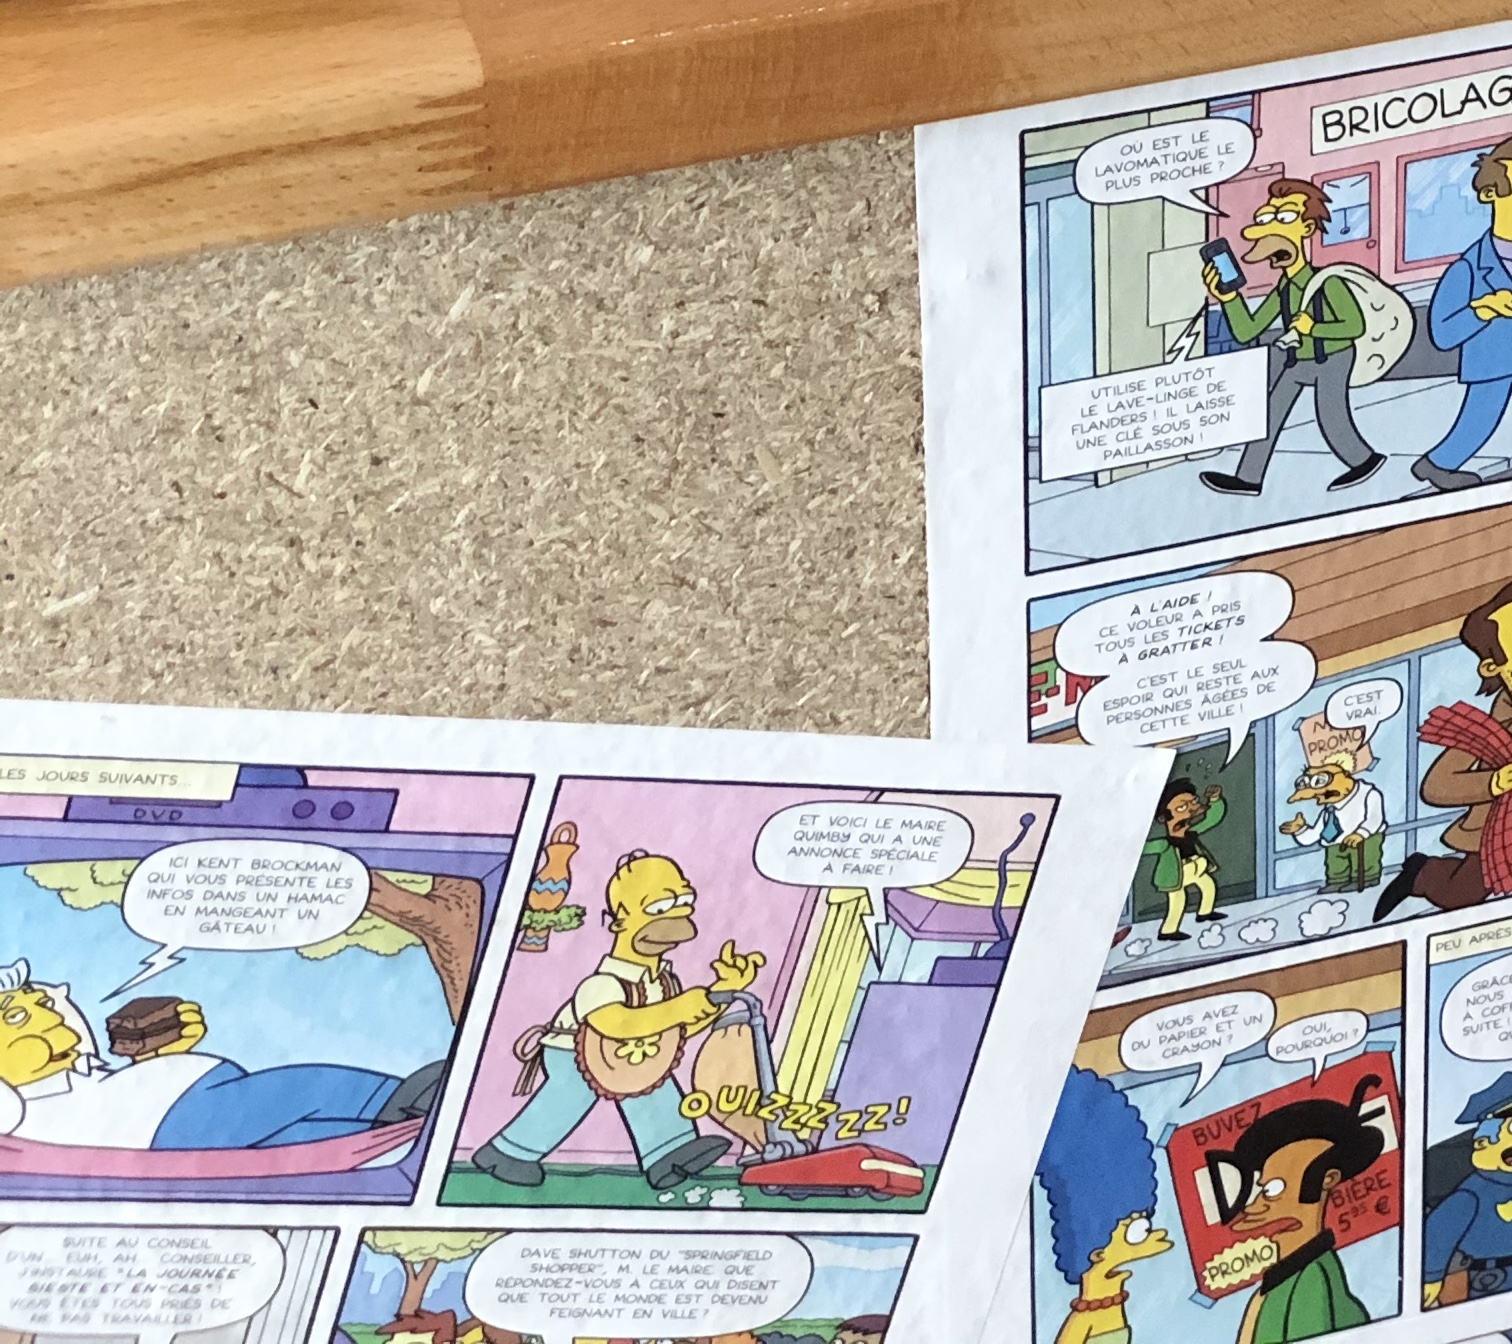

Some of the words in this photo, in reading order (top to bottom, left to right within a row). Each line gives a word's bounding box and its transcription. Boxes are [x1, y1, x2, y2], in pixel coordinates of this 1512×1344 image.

[1152, 135, 1182, 151] EST
[1191, 129, 1210, 145] LE
[1095, 146, 1209, 178] LAVOMATIQUE
[1217, 142, 1235, 156] LE
[1105, 175, 1141, 192] PLUS
[1150, 162, 1213, 184] PROCHE
[1080, 404, 1099, 419] LE
[1106, 385, 1199, 414] LAVE-LINGE
[1206, 380, 1227, 395] DE
[1090, 379, 1147, 400] UTILISE
[1071, 411, 1148, 436] FLANDERS
[1166, 406, 1178, 418] IL
[1186, 394, 1236, 414] LAISSE
[1076, 434, 1108, 451] UNE
[1151, 419, 1191, 436] SOUS
[1199, 410, 1231, 427] SON
[1103, 433, 1194, 461] PAILLASSON
[1149, 592, 1201, 613] L'AIDE
[1099, 624, 1119, 638] CE
[1127, 612, 1184, 633] VOLEUR
[1192, 608, 1204, 620] A
[1211, 600, 1241, 616] PRIS
[1094, 636, 1135, 654] TOUS
[1144, 629, 1169, 645] LES
[1177, 614, 1246, 638] TICKETS
[1137, 636, 1213, 661] GRATTER
[1343, 689, 1384, 707] C'EST
[1308, 729, 1363, 756] PROMO
[36, 770, 90, 783] JOURS
[133, 807, 184, 822] DVD
[799, 814, 821, 826] ET
[829, 815, 868, 828] VOICI
[875, 818, 894, 830] LE
[900, 819, 947, 832] MAIRE
[793, 829, 852, 844] QUIMBY
[858, 832, 885, 844] QUI
[891, 834, 903, 845] A
[912, 835, 943, 847] UNE
[787, 846, 863, 859] ANNONCE
[169, 856, 189, 869] ICI
[197, 857, 243, 870] KENT
[250, 858, 343, 873] BROCKMAN
[842, 862, 885, 876] FAIRE
[147, 872, 176, 884] QUI
[186, 873, 228, 886] VOUS
[325, 877, 354, 890] LES
[146, 888, 194, 901] INFOS
[202, 889, 247, 902] DANS
[256, 891, 279, 903] UN
[286, 892, 346, 905] HAMAC
[163, 904, 187, 916] EN
[194, 905, 289, 919] MANGEANT
[297, 908, 320, 921] UN
[1435, 937, 1463, 953] PEU
[1192, 1103, 1262, 1148] BUVEZ
[1207, 1244, 1276, 1282] PROMO
